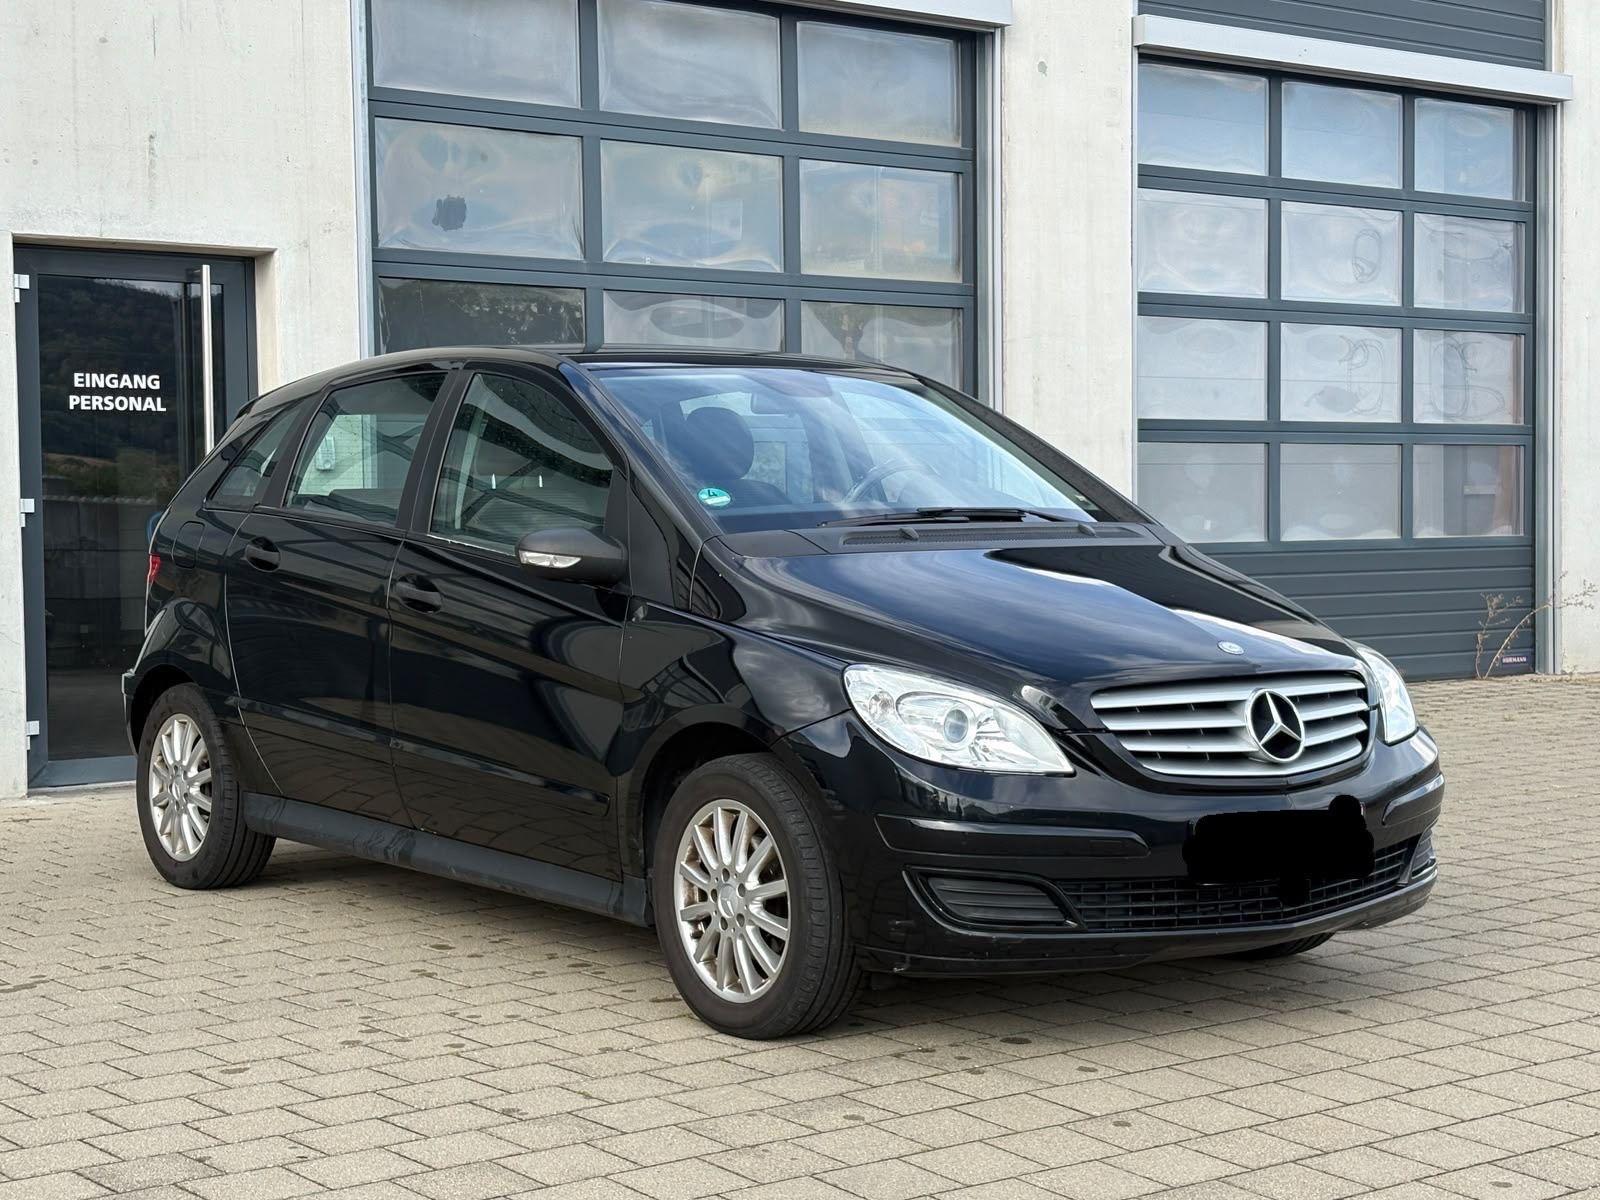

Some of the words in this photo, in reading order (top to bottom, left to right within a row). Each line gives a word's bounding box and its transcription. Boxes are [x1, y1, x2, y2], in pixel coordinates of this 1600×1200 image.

[73, 372, 160, 390] EINGANG
[68, 395, 167, 411] PERSONAL
[707, 489, 718, 497] 4
